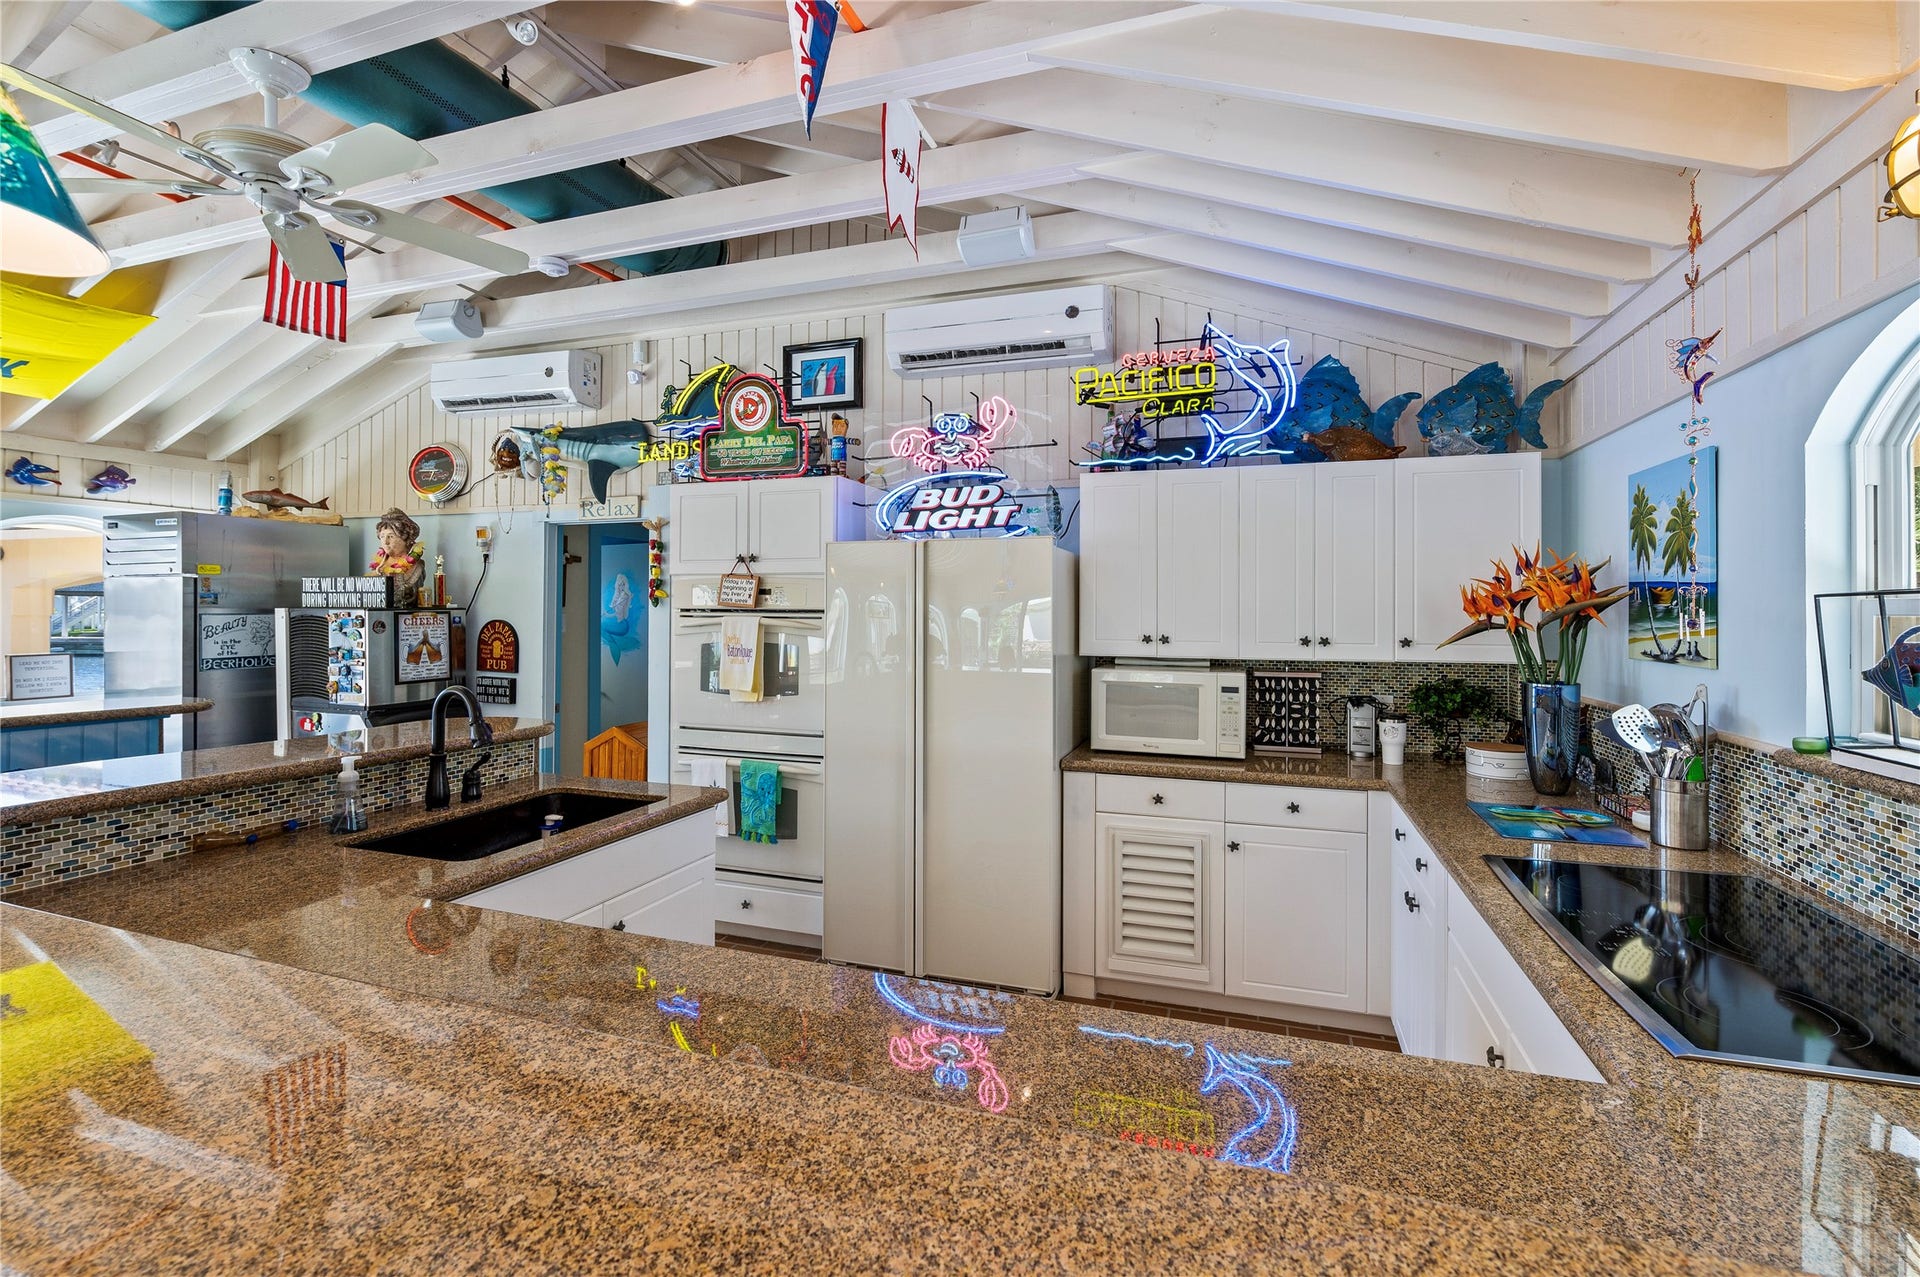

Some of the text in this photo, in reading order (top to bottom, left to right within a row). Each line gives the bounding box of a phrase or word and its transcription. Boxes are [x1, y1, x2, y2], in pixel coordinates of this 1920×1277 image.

[1122, 347, 1216, 367] CERVEZA
[1075, 362, 1216, 405] PACIFICO
[1142, 396, 1215, 417] CLARA
[710, 434, 794, 449] LARRY DEL PAPA
[911, 484, 1004, 510] BUD
[580, 499, 635, 517] Relax
[893, 504, 1022, 532] LIGHT
[302, 577, 386, 592] THERE WILL BE NO WORKING
[302, 592, 386, 608] DURING DRINKING HOURS
[203, 615, 248, 640] BEAUTY
[403, 616, 445, 626] CHEERS
[481, 625, 495, 642] DEL
[495, 621, 515, 643] PAPA'S
[203, 657, 275, 670] BEERHOLDE
[486, 659, 508, 670] PUB
